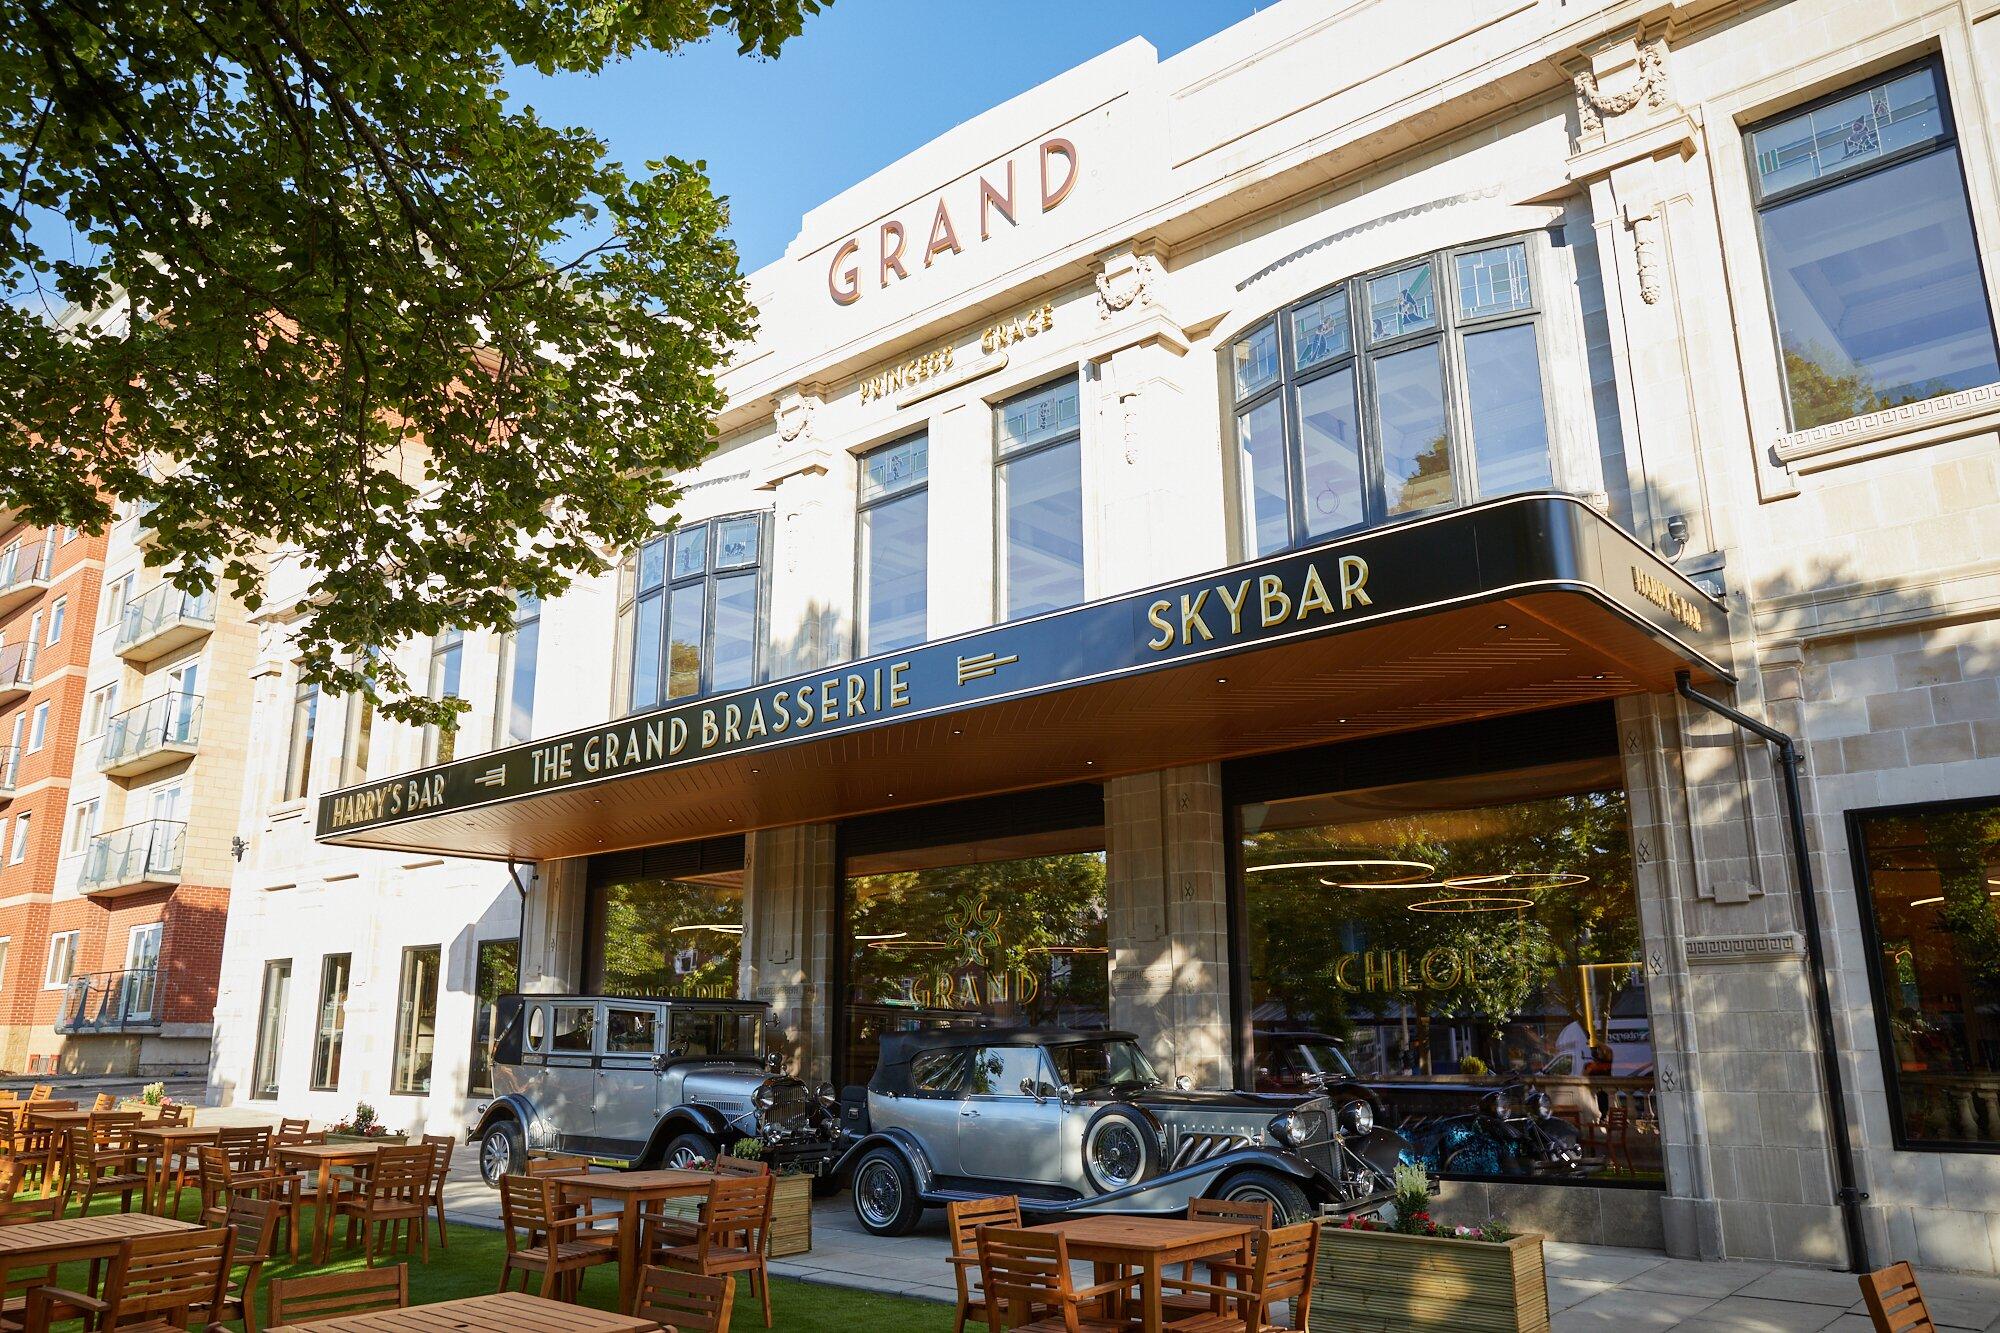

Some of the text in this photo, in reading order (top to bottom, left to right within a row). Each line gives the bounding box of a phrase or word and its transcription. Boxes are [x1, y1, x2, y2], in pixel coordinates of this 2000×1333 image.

[828, 138, 1079, 306] GRAND
[859, 303, 1055, 404] PRINCESS GRACE
[1147, 555, 1374, 651] SKYBAR
[531, 661, 911, 785] THE GRAND BRASSERIE
[332, 774, 446, 828] HARRY'S BAR
[911, 969, 1039, 1010] GRAND
